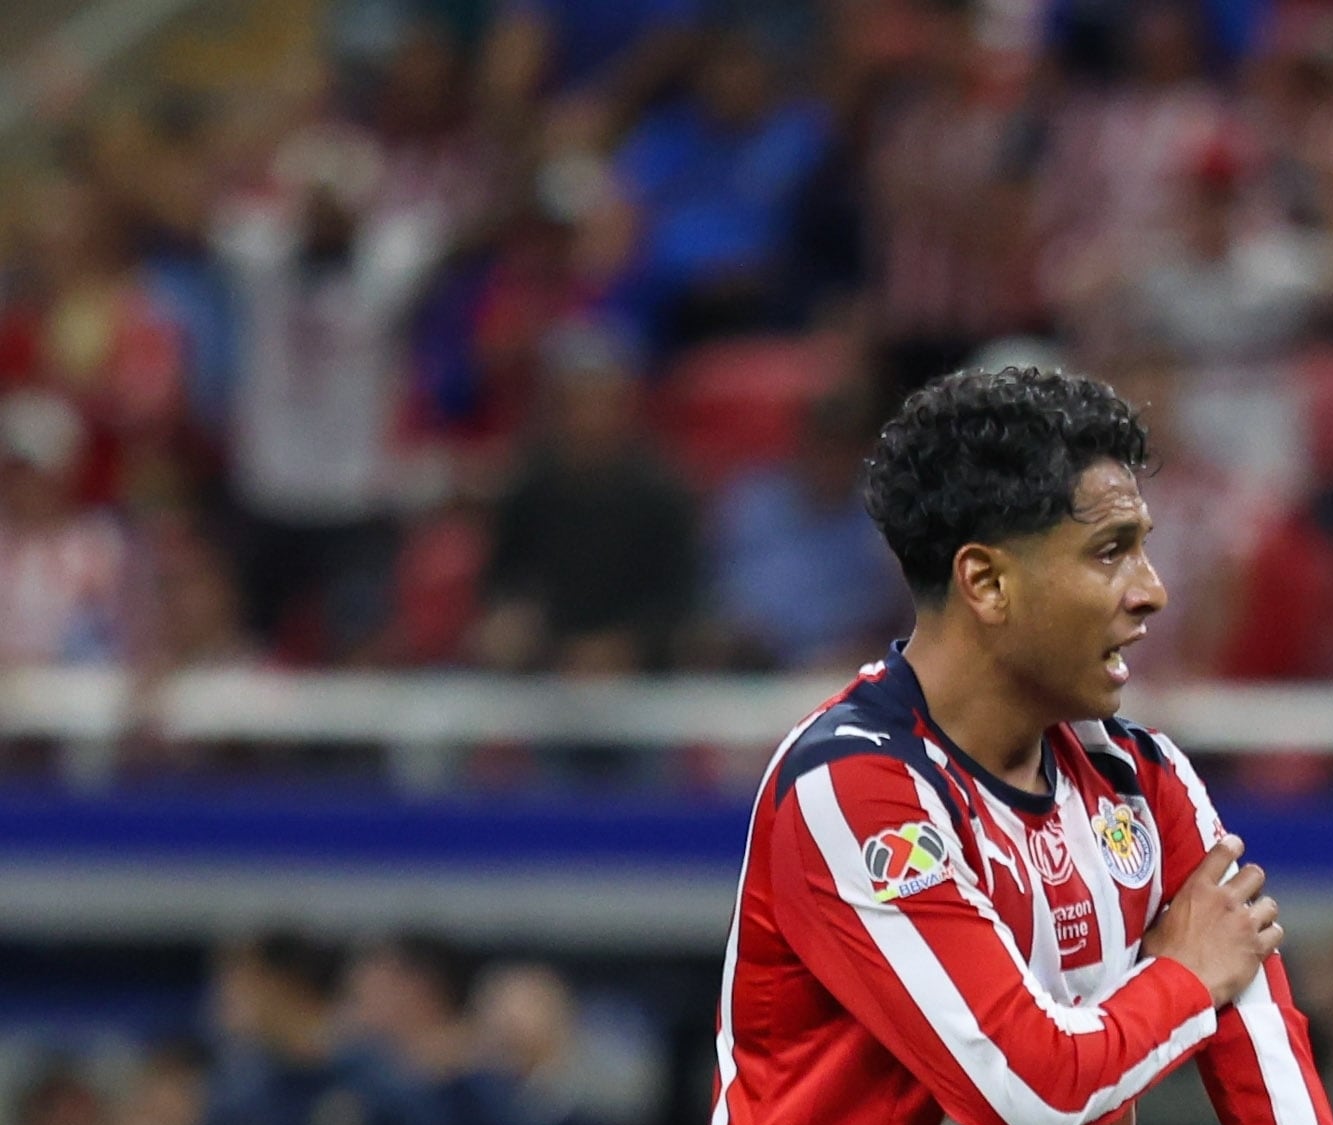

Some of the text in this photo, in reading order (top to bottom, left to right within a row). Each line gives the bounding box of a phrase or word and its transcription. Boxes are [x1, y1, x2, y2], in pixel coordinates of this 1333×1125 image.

[899, 873, 939, 897] BBVA
[1054, 900, 1092, 921] azon
[1057, 921, 1088, 940] ime
